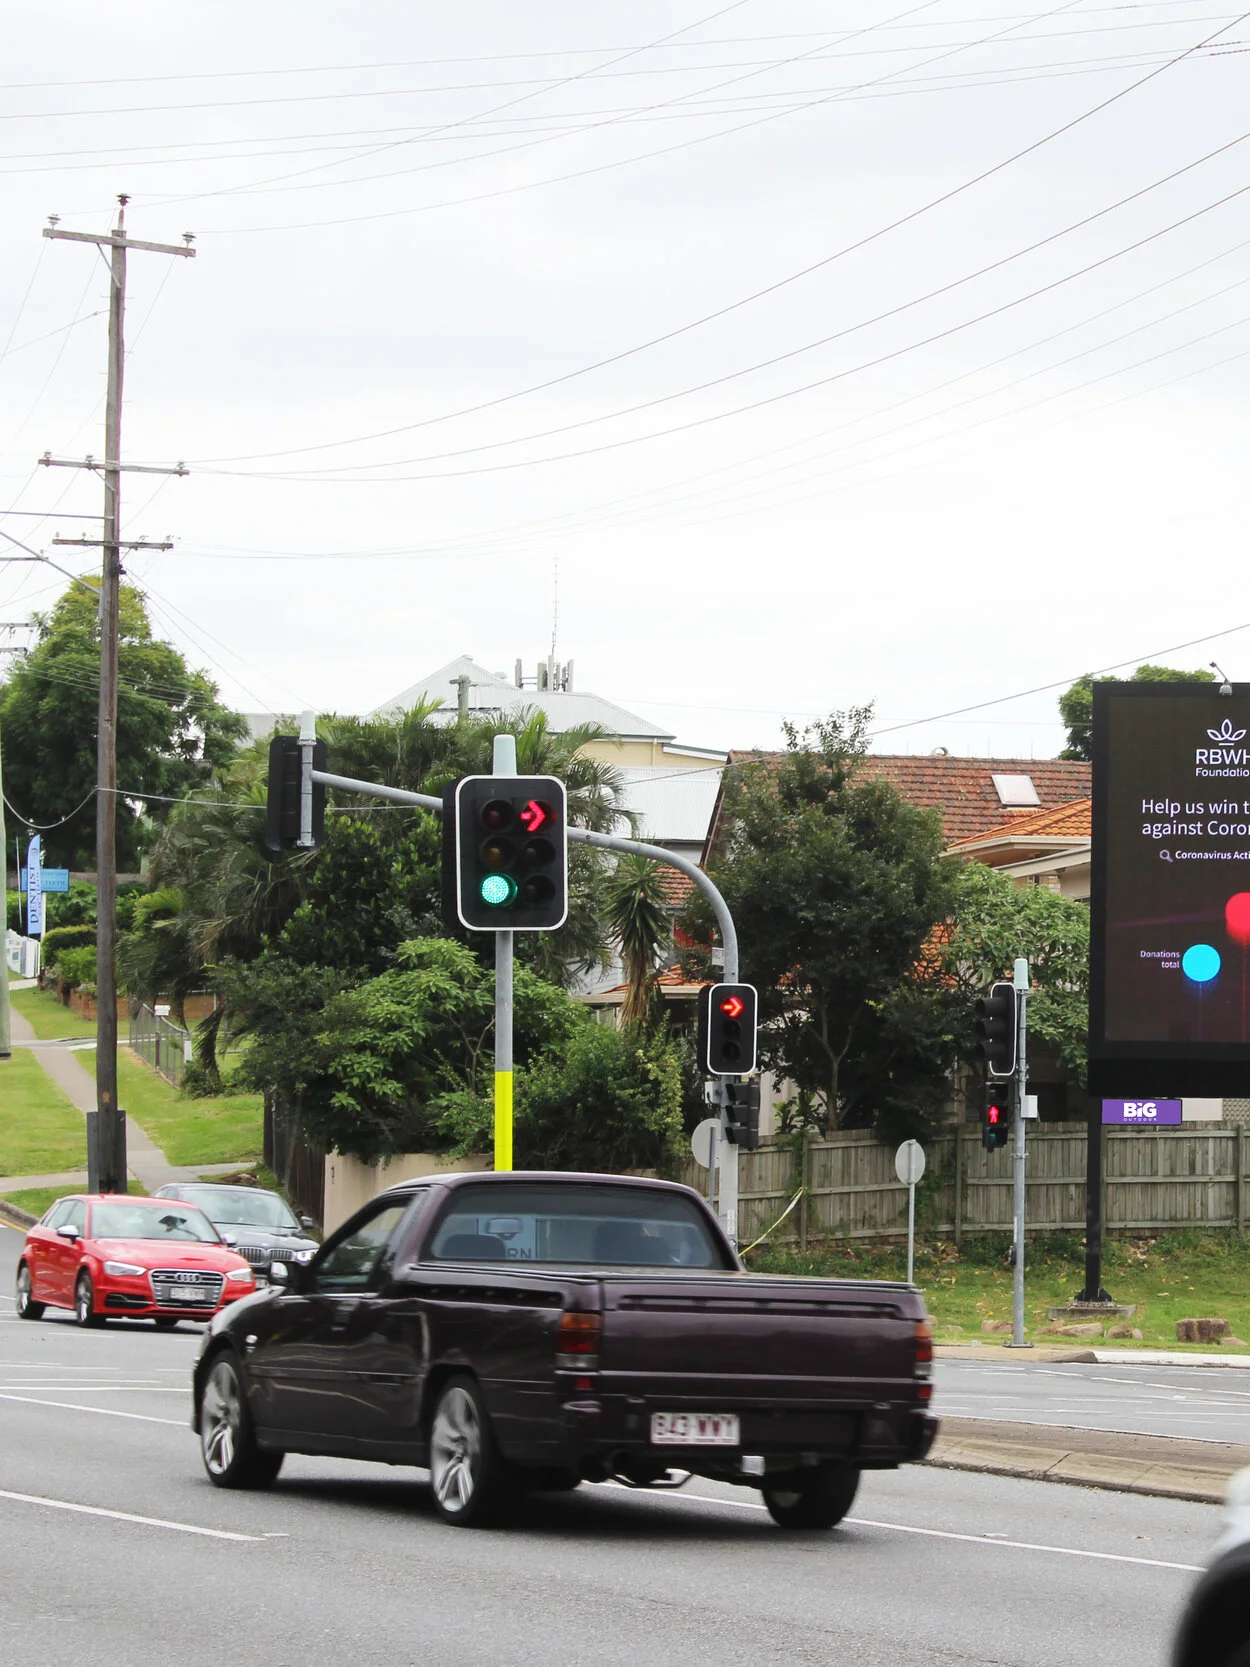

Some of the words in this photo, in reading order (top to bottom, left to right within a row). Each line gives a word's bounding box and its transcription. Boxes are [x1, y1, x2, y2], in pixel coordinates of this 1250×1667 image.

[1142, 798, 1181, 818] Help
[1185, 802, 1204, 814] us
[1208, 799, 1239, 814] win
[1142, 820, 1203, 839] against
[1175, 850, 1232, 860] Coronavirus
[29, 864, 39, 924] DENTIST
[1140, 950, 1181, 958] Donations
[1161, 961, 1180, 969] total
